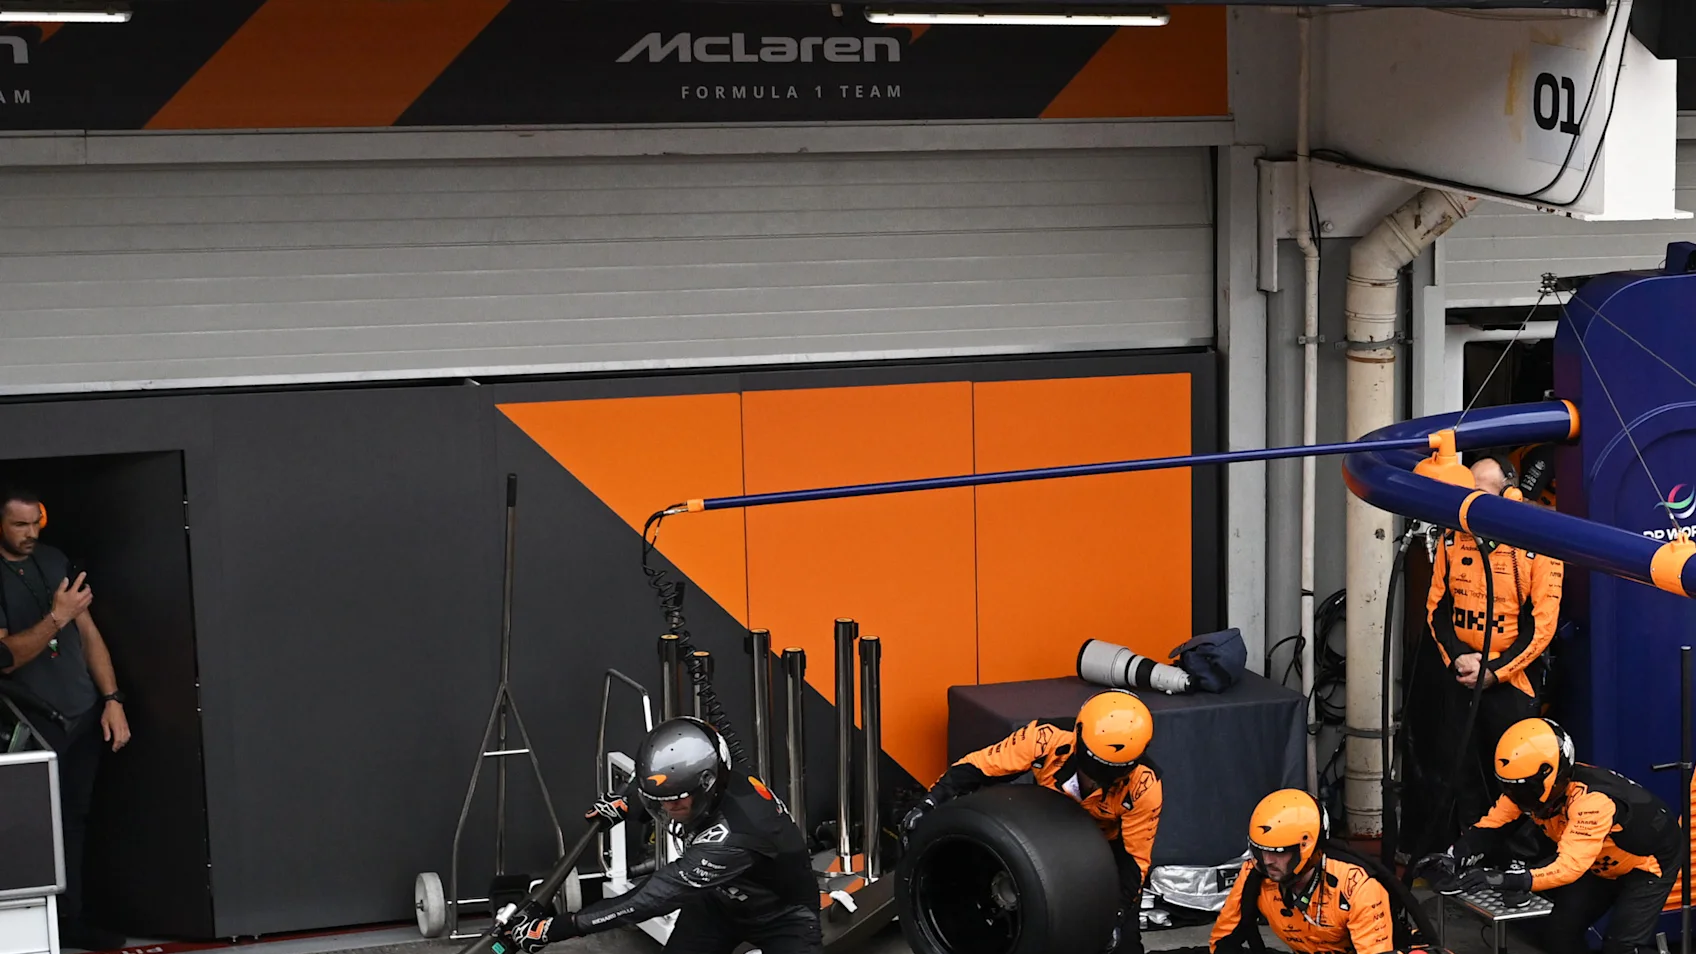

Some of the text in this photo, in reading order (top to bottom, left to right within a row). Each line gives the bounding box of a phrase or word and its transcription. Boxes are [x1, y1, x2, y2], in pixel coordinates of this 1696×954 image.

[615, 32, 900, 62] McLaren
[681, 85, 901, 99] FORMULA 1 TEAM
[1534, 72, 1580, 136] 01
